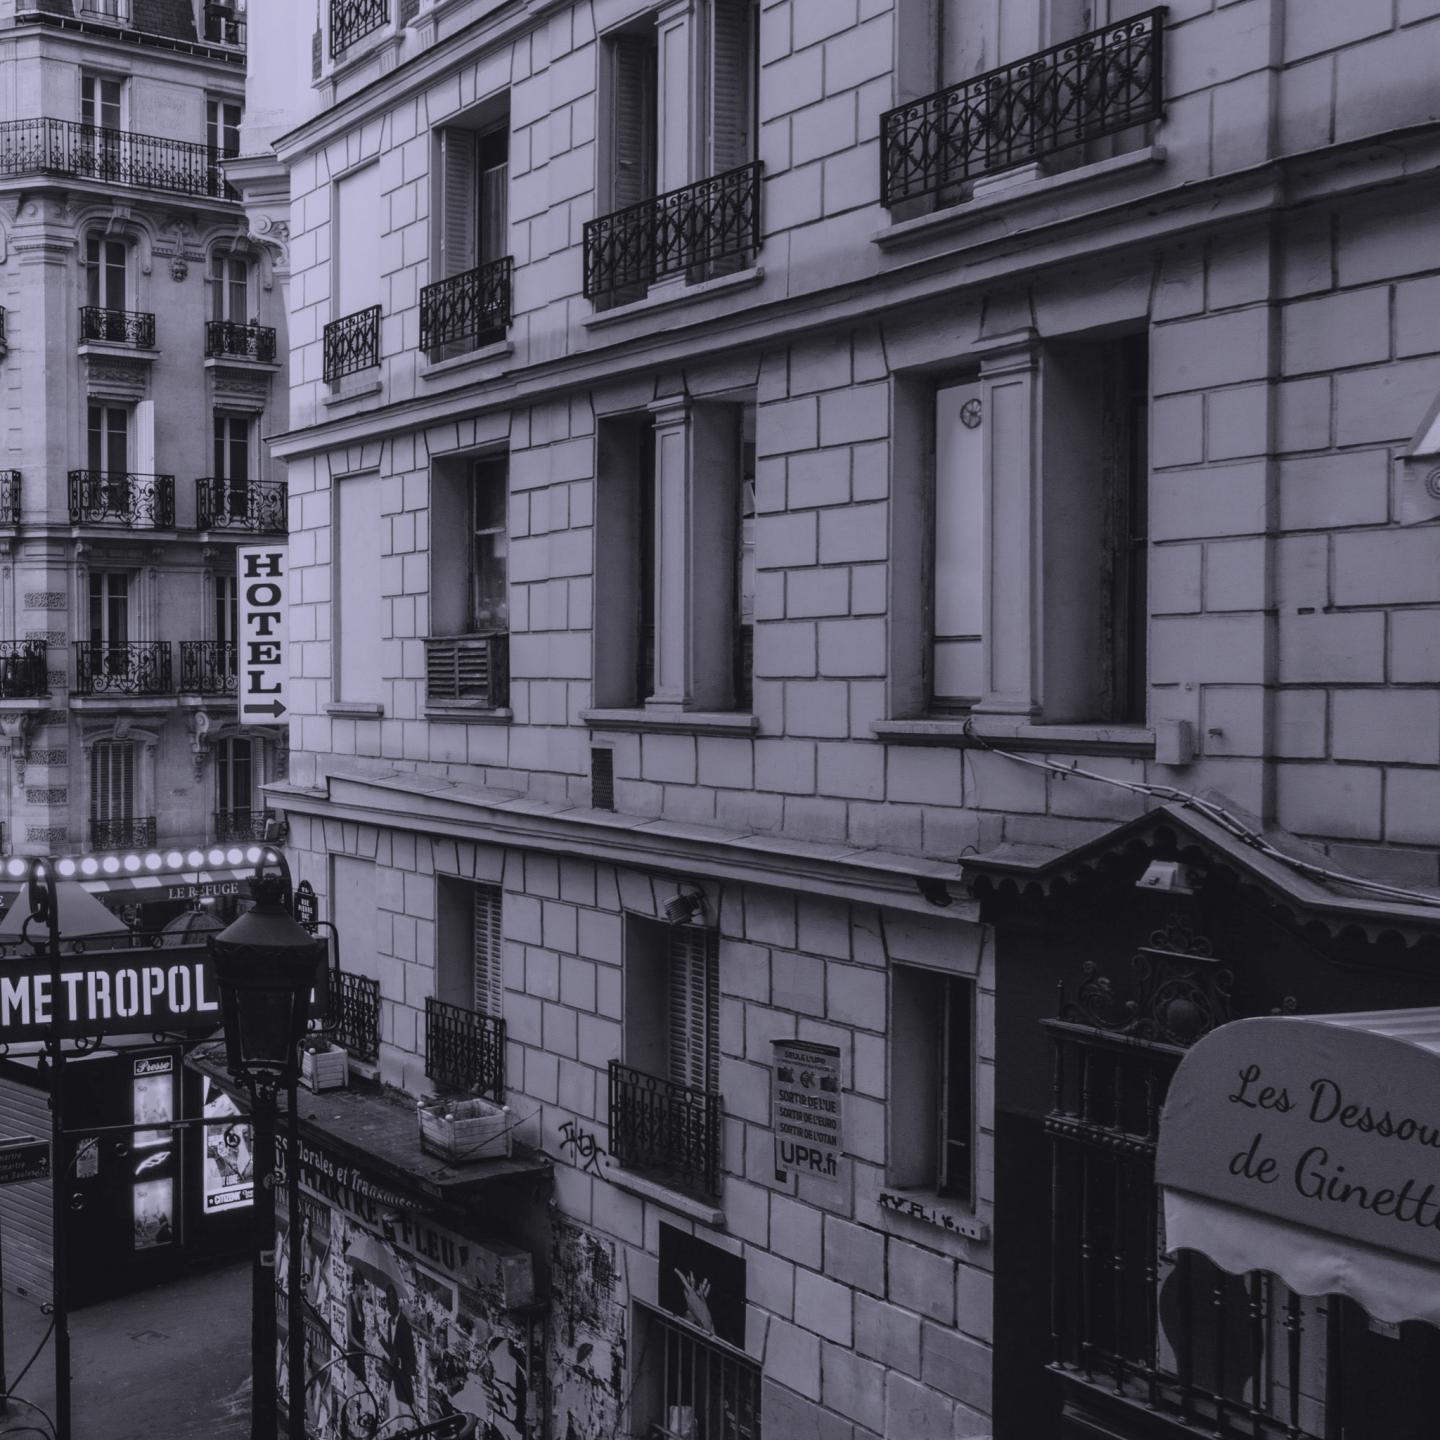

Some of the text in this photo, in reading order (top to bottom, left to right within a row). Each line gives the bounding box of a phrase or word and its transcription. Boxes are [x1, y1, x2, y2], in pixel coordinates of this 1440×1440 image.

[243, 553, 283, 694] HOTEL
[168, 887, 185, 899] LE
[778, 1089, 807, 1106] SORTIR
[807, 1095, 819, 1110] DE
[1227, 1063, 1297, 1113] Les
[779, 1106, 803, 1121] SORTIR
[779, 1122, 804, 1138] SORTIR
[297, 1139, 334, 1178] lorales
[1228, 1132, 1280, 1184] de
